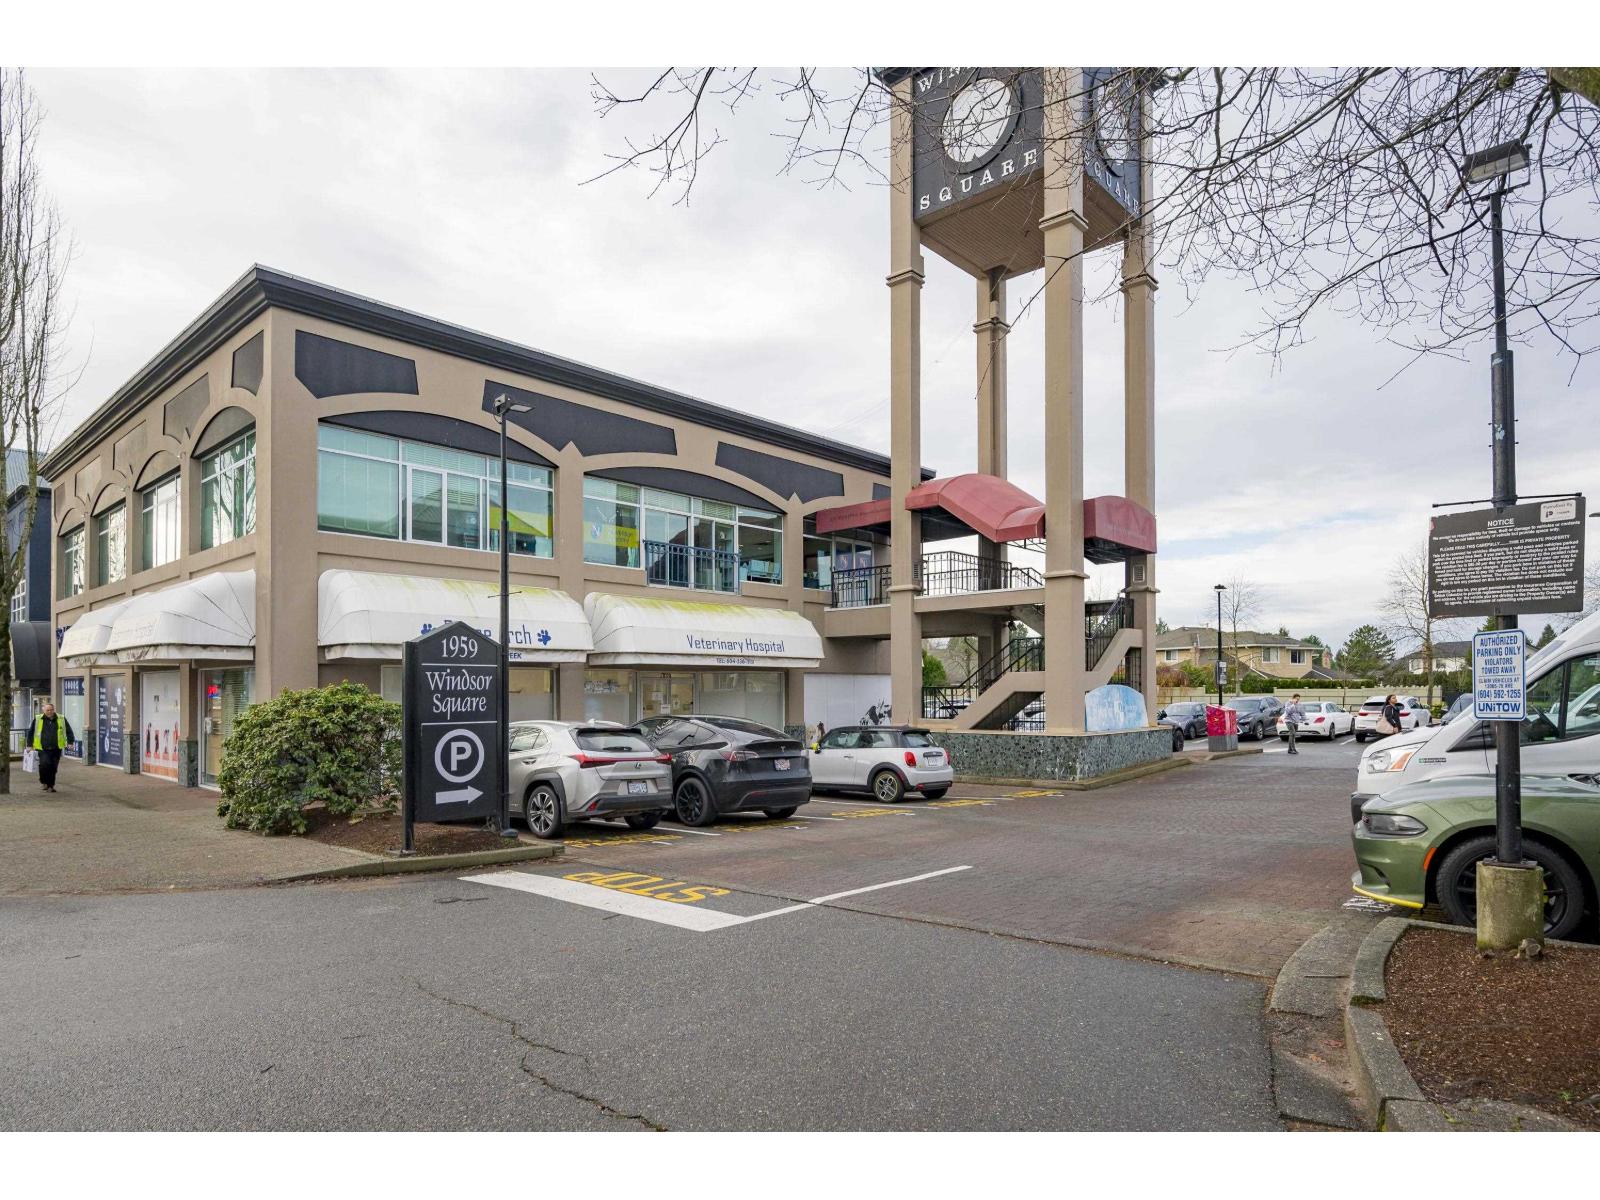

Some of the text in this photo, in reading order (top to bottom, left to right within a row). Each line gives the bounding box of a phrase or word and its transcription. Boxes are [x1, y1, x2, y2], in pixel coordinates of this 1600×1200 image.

[918, 67, 972, 94] WIN
[919, 149, 1038, 211] SQUARE
[1488, 518, 1514, 527] NOTICE
[441, 636, 478, 658] 1959
[686, 634, 784, 654] Veterinary Hospital
[1476, 646, 1520, 657] PARKING ONLY
[1480, 636, 1518, 646] AUTHORIZED
[1484, 657, 1513, 665] VIOLATORS
[426, 668, 492, 691] Windsor
[1478, 690, 1521, 699] (604) 592-1255
[432, 693, 487, 720] Square
[450, 741, 472, 772] P
[562, 871, 732, 903] STOP
